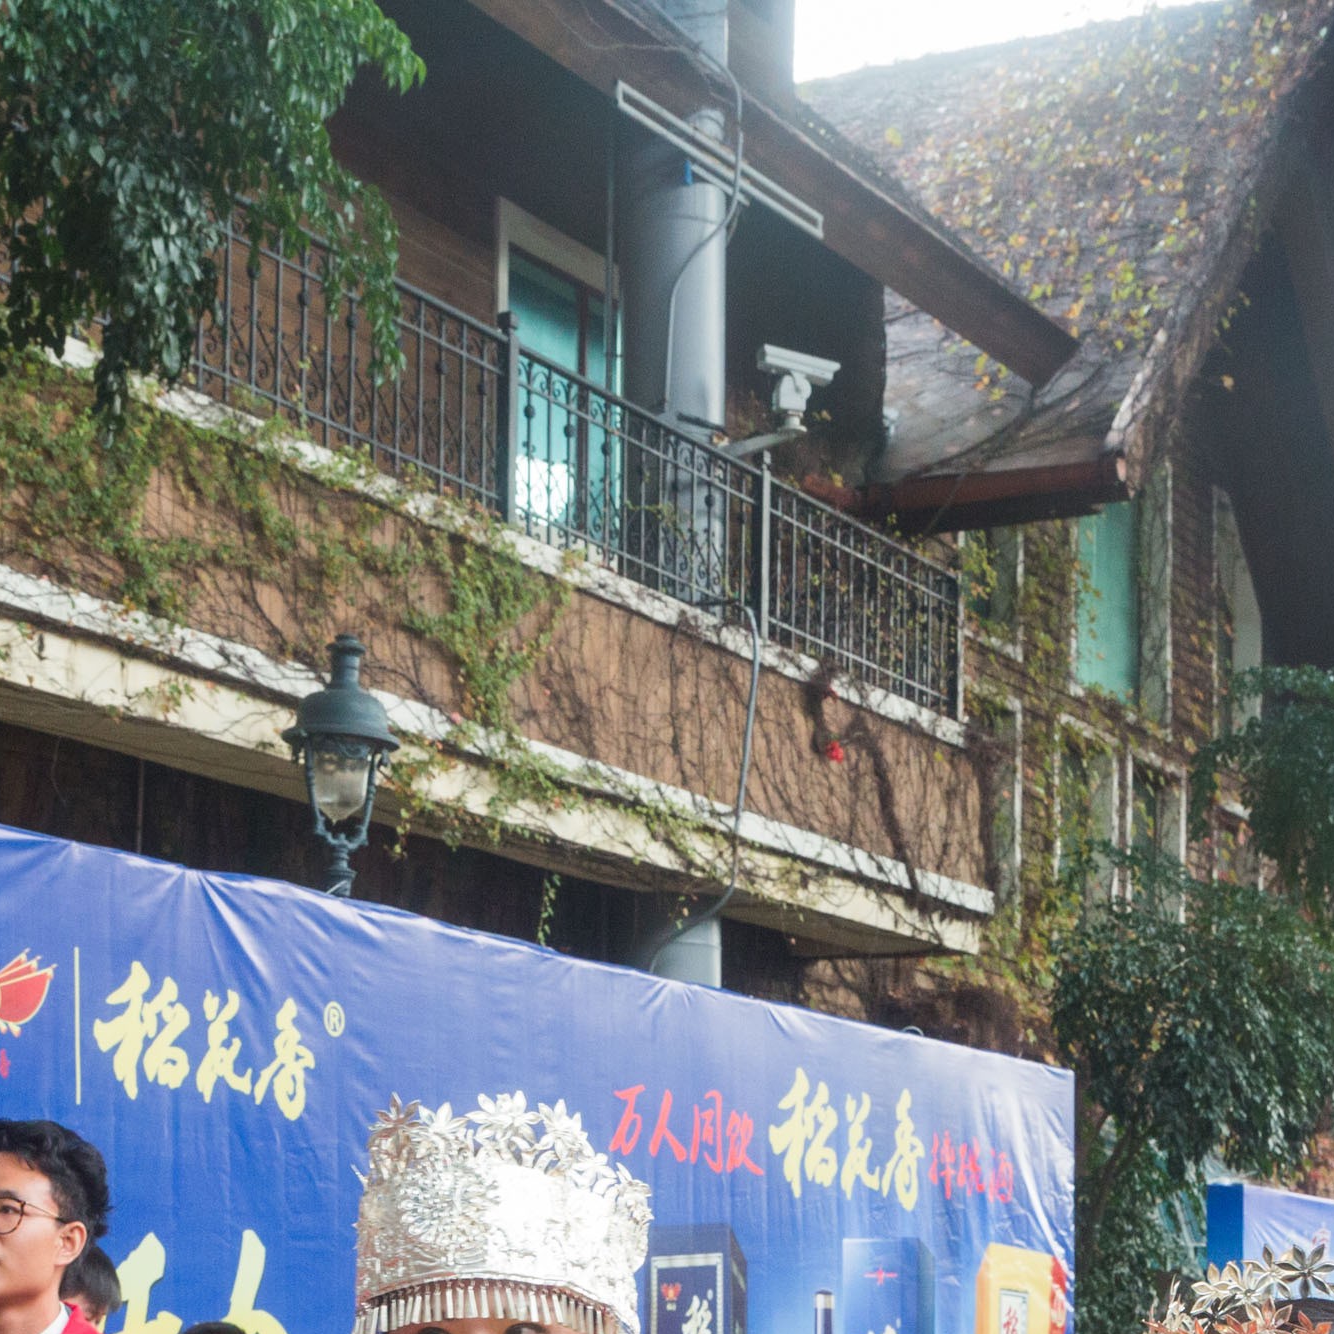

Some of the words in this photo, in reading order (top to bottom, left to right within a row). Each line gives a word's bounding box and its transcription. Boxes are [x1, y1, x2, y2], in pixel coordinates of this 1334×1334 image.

[94, 961, 315, 1121] 稻花香
[769, 1067, 926, 1211] 稻花香
